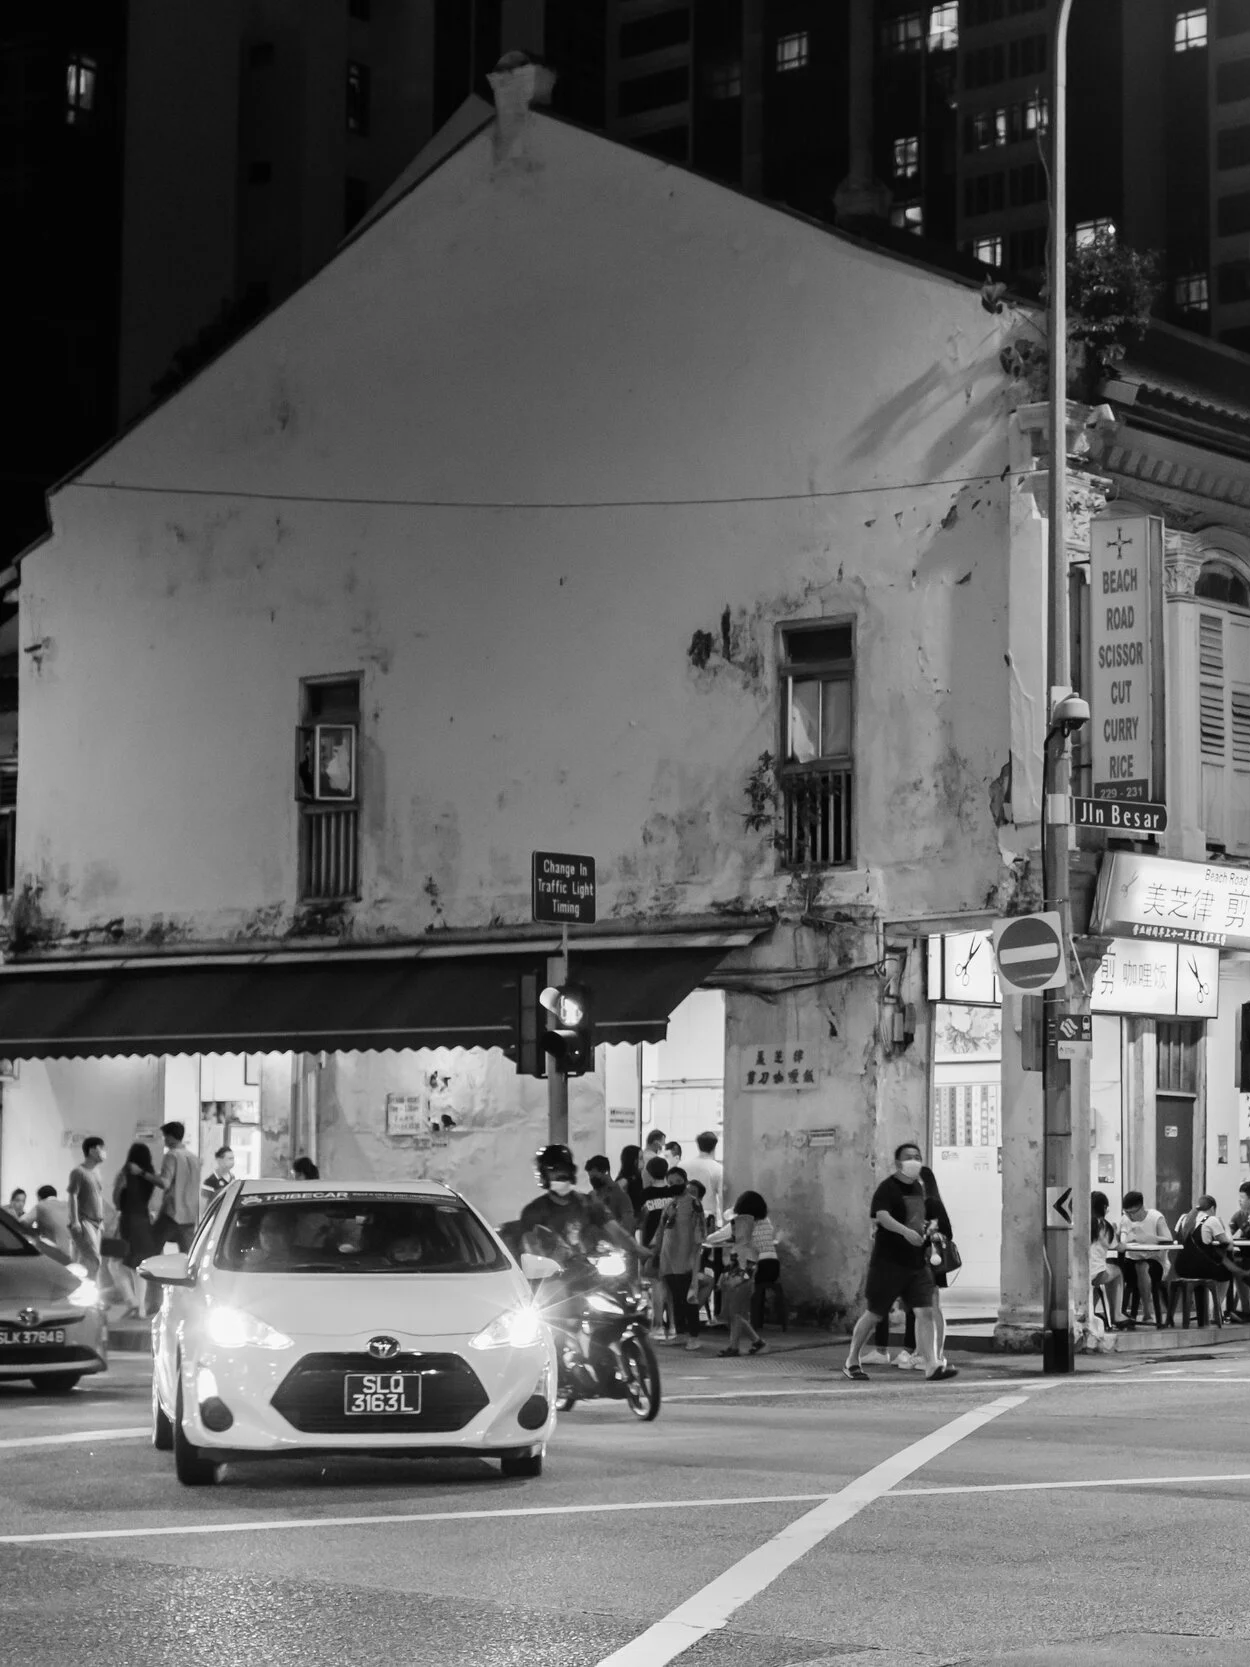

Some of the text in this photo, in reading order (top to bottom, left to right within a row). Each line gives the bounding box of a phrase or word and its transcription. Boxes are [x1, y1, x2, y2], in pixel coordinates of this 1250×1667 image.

[1102, 567, 1138, 594] BEACH
[1106, 605, 1135, 631] ROAD
[1099, 641, 1143, 668] SCISSOR
[1111, 680, 1133, 705] CUT
[1103, 716, 1139, 743] CURRY
[1109, 754, 1134, 779] RICE
[1100, 786, 1118, 799] 229
[1127, 785, 1143, 798] 231
[1080, 801, 1160, 829] Jln Besar
[543, 859, 588, 878] Change In
[1204, 868, 1228, 883] Beach
[1229, 872, 1248, 886] Road
[537, 878, 594, 898] Traffic Light
[552, 900, 580, 917] Timing
[1143, 882, 1216, 923] 美芝律
[265, 1191, 349, 1201] TRIBECAR
[362, 1375, 404, 1394] SLQ
[351, 1393, 416, 1413] 3163L
